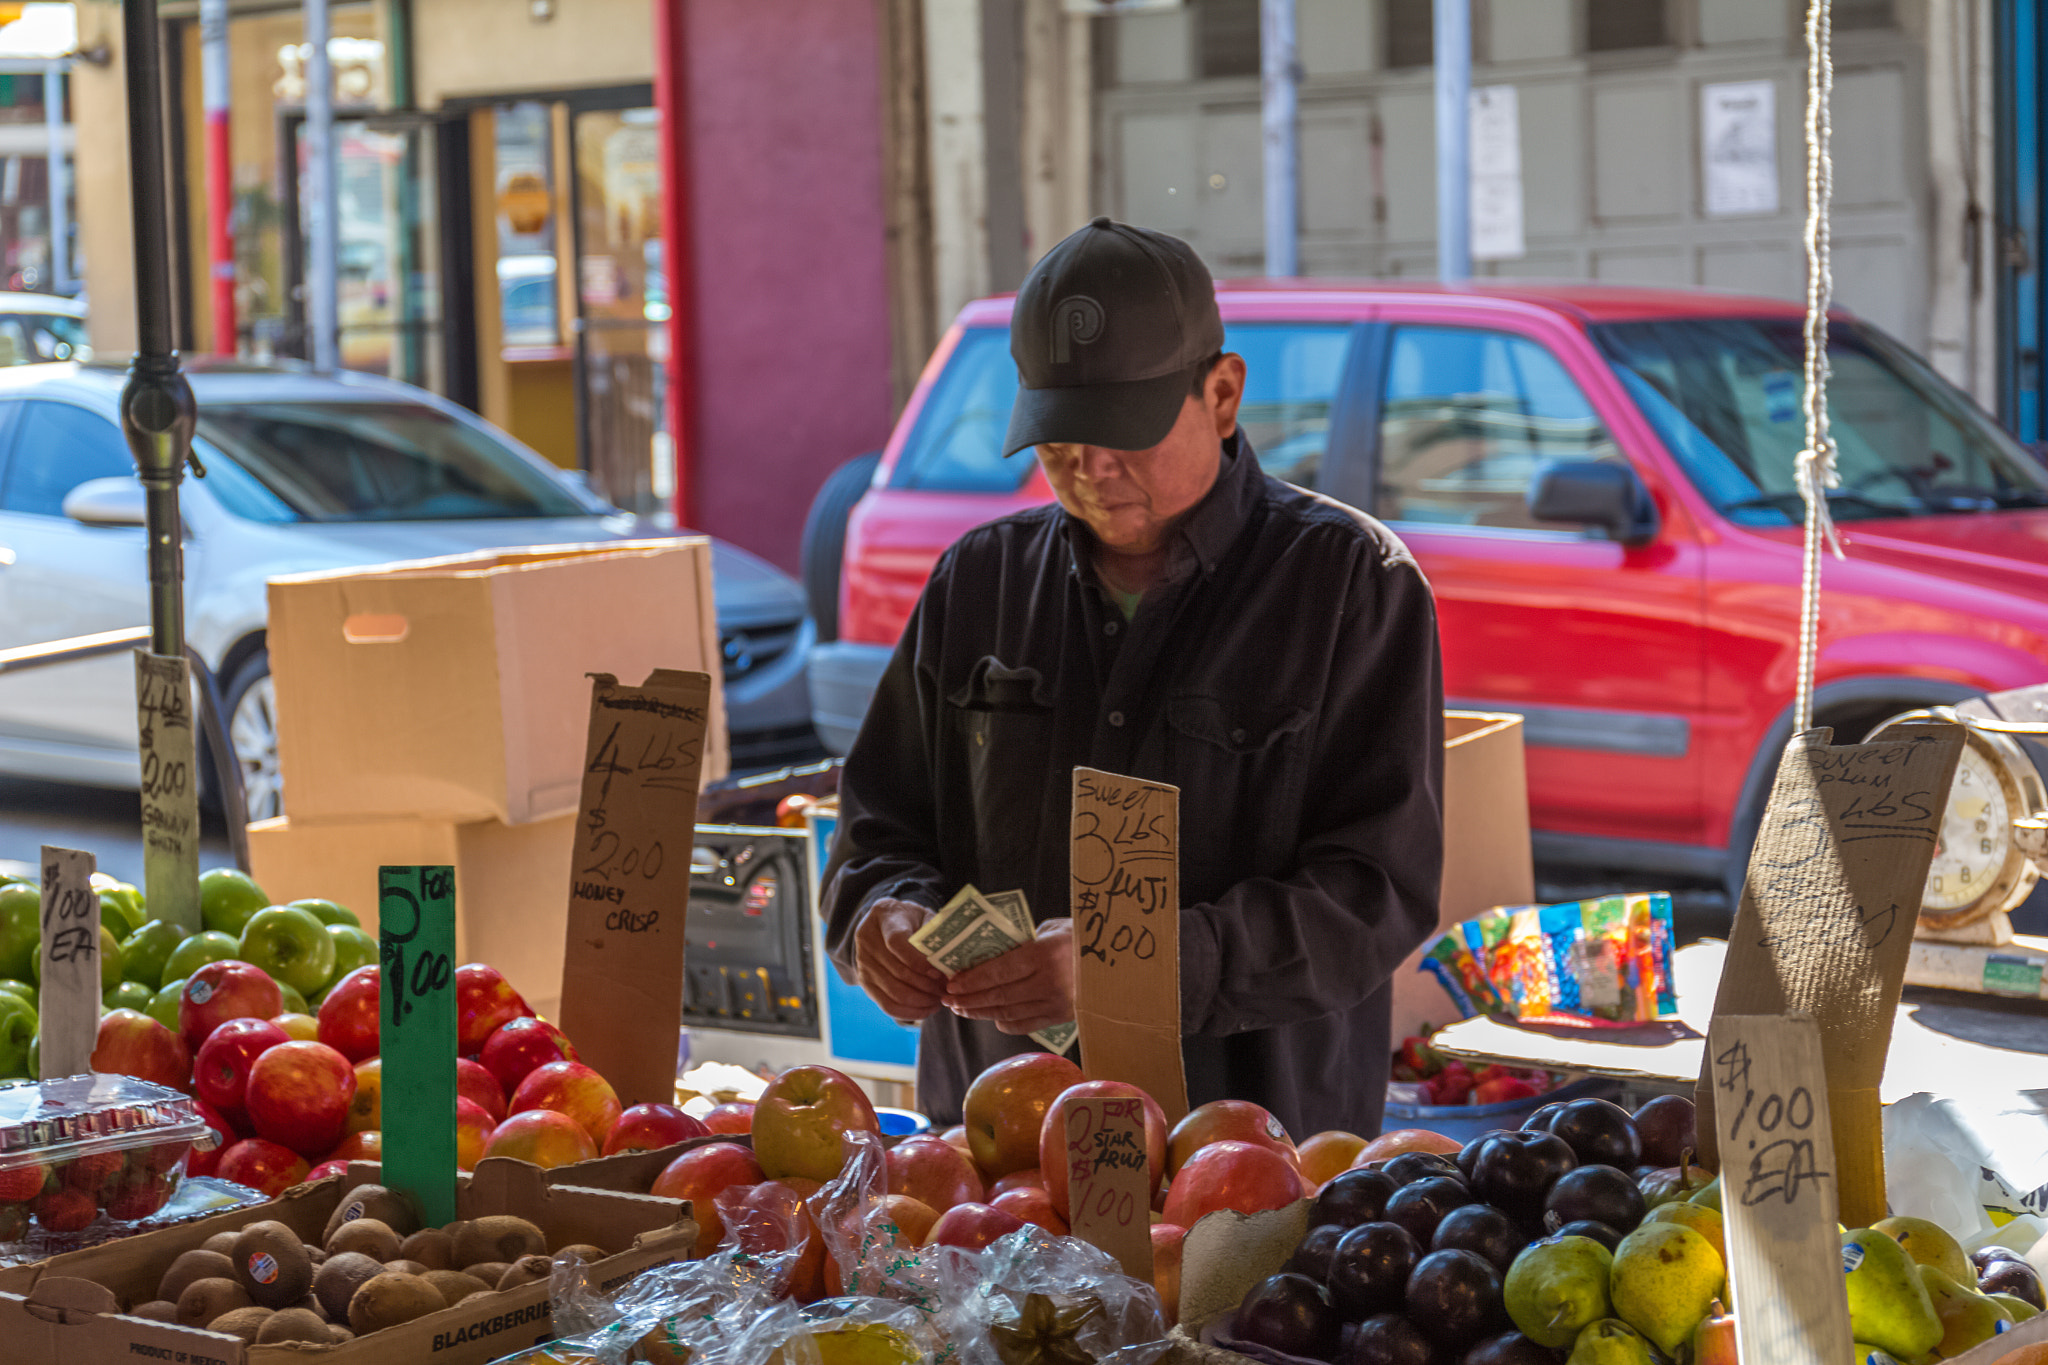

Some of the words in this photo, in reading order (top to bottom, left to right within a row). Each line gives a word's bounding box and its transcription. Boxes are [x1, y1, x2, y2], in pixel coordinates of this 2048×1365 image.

[140, 674, 157, 728] 4
[588, 721, 633, 805] 4
[1961, 768, 1971, 787] 2
[588, 808, 607, 834] $
[583, 831, 664, 881] 2.00
[1072, 811, 1114, 886] 3
[1980, 837, 1992, 855] 6
[1960, 866, 1972, 884] 8
[573, 881, 625, 905] HONEY
[1076, 887, 1099, 915] $
[49, 926, 97, 964] EA
[1080, 912, 1156, 967] 2.00
[1716, 1039, 1752, 1092] $
[1068, 1105, 1093, 1155] 2
[1093, 1128, 1138, 1150] STAR
[1071, 1157, 1093, 1188] $
[432, 1298, 556, 1353] BLACKBERRIE
[130, 1342, 172, 1361] PRODUCT
[175, 1351, 188, 1363] OF
